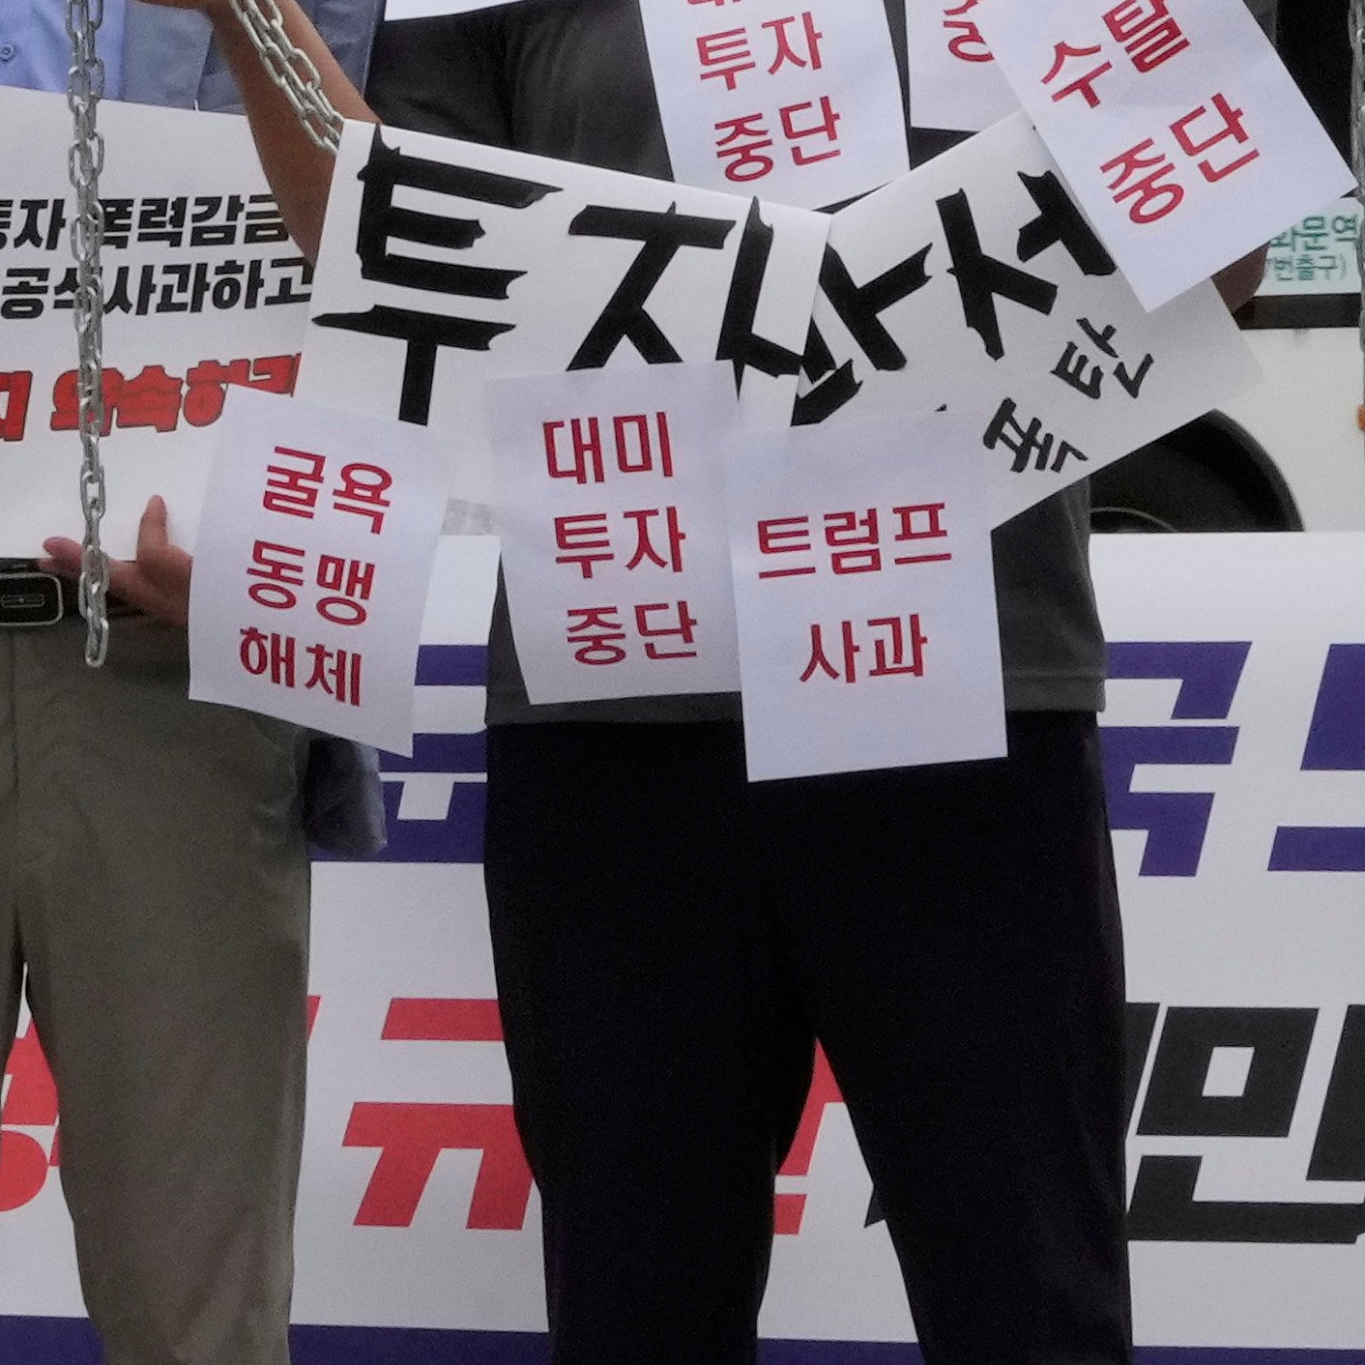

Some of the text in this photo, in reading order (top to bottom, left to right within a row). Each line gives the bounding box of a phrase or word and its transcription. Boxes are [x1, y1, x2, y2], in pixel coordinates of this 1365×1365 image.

[695, 11, 822, 91] 투자
[715, 96, 841, 183] 중단
[1100, 92, 1260, 225] 중단
[983, 316, 1155, 473] 폭탄
[542, 410, 675, 485] 대미
[262, 446, 394, 535] 굴욕
[554, 508, 687, 580] 투자
[756, 501, 953, 579] 트럼프
[246, 539, 376, 626] 동맹
[238, 627, 361, 707] 해체
[565, 600, 698, 666] 중단
[800, 614, 927, 685] 사과
